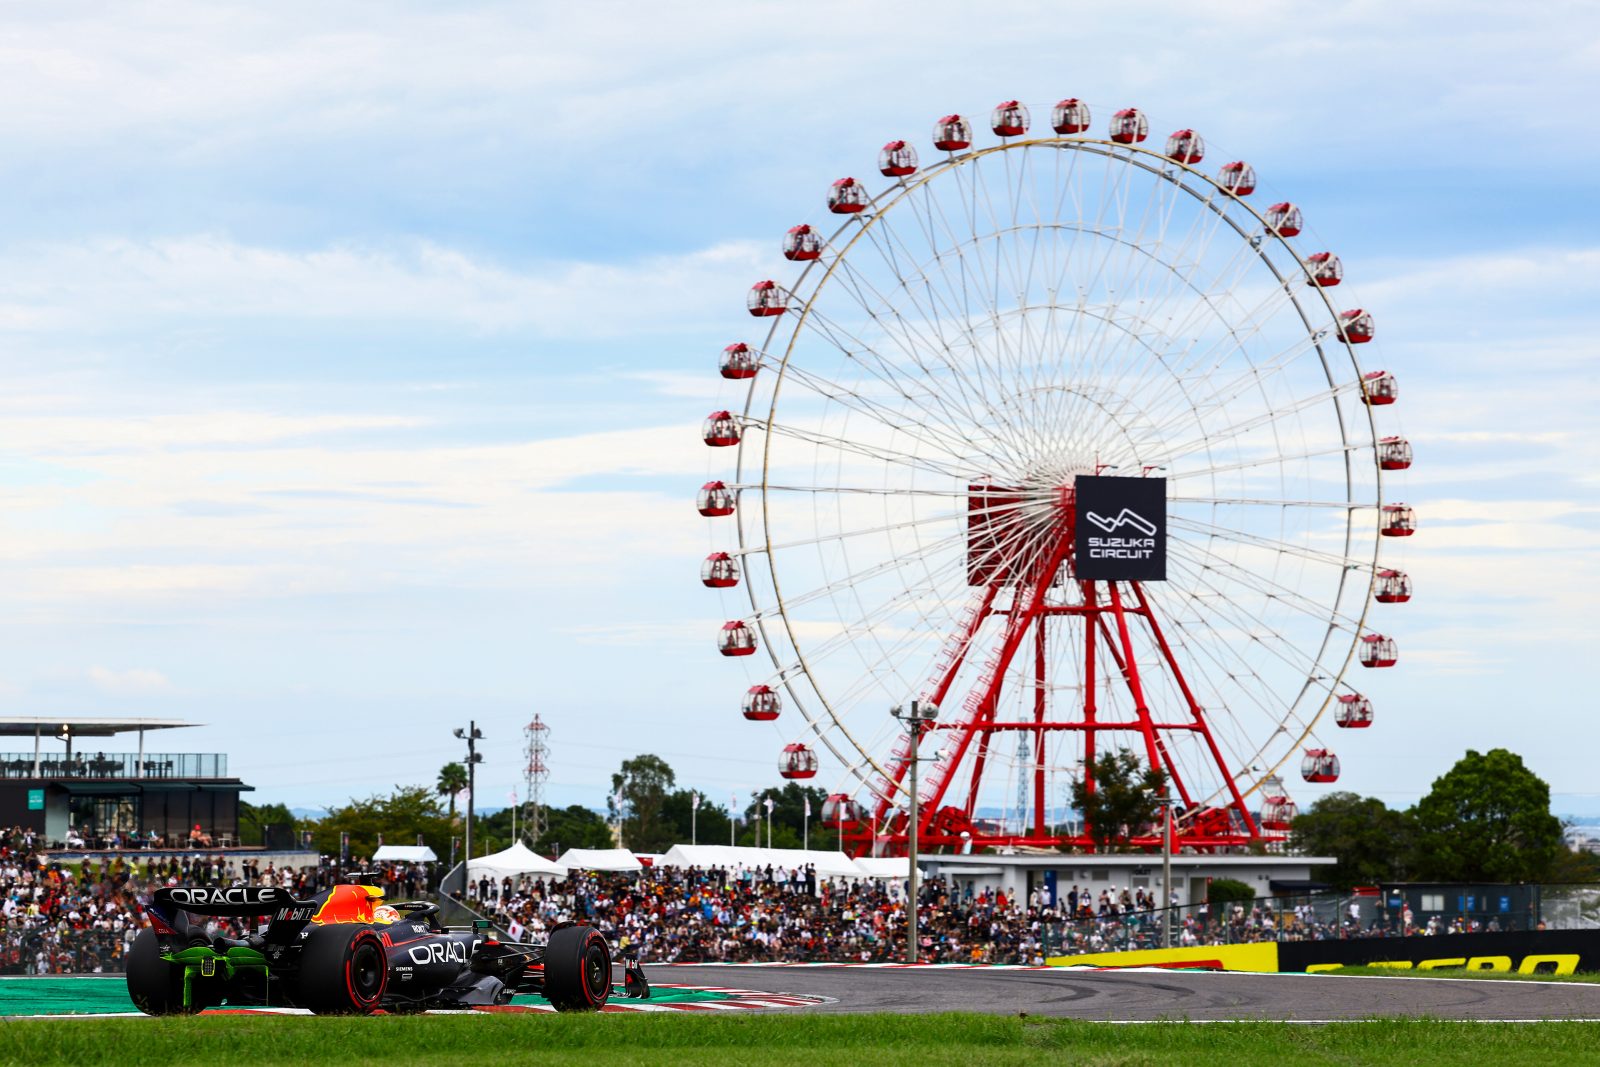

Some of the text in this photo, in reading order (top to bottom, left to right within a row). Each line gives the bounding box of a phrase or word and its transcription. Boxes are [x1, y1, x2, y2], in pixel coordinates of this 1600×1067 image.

[1088, 537, 1155, 548] SUZUKA
[1089, 549, 1153, 559] CIRCUIT
[169, 888, 276, 905] ORACLE
[277, 908, 305, 920] Mobil
